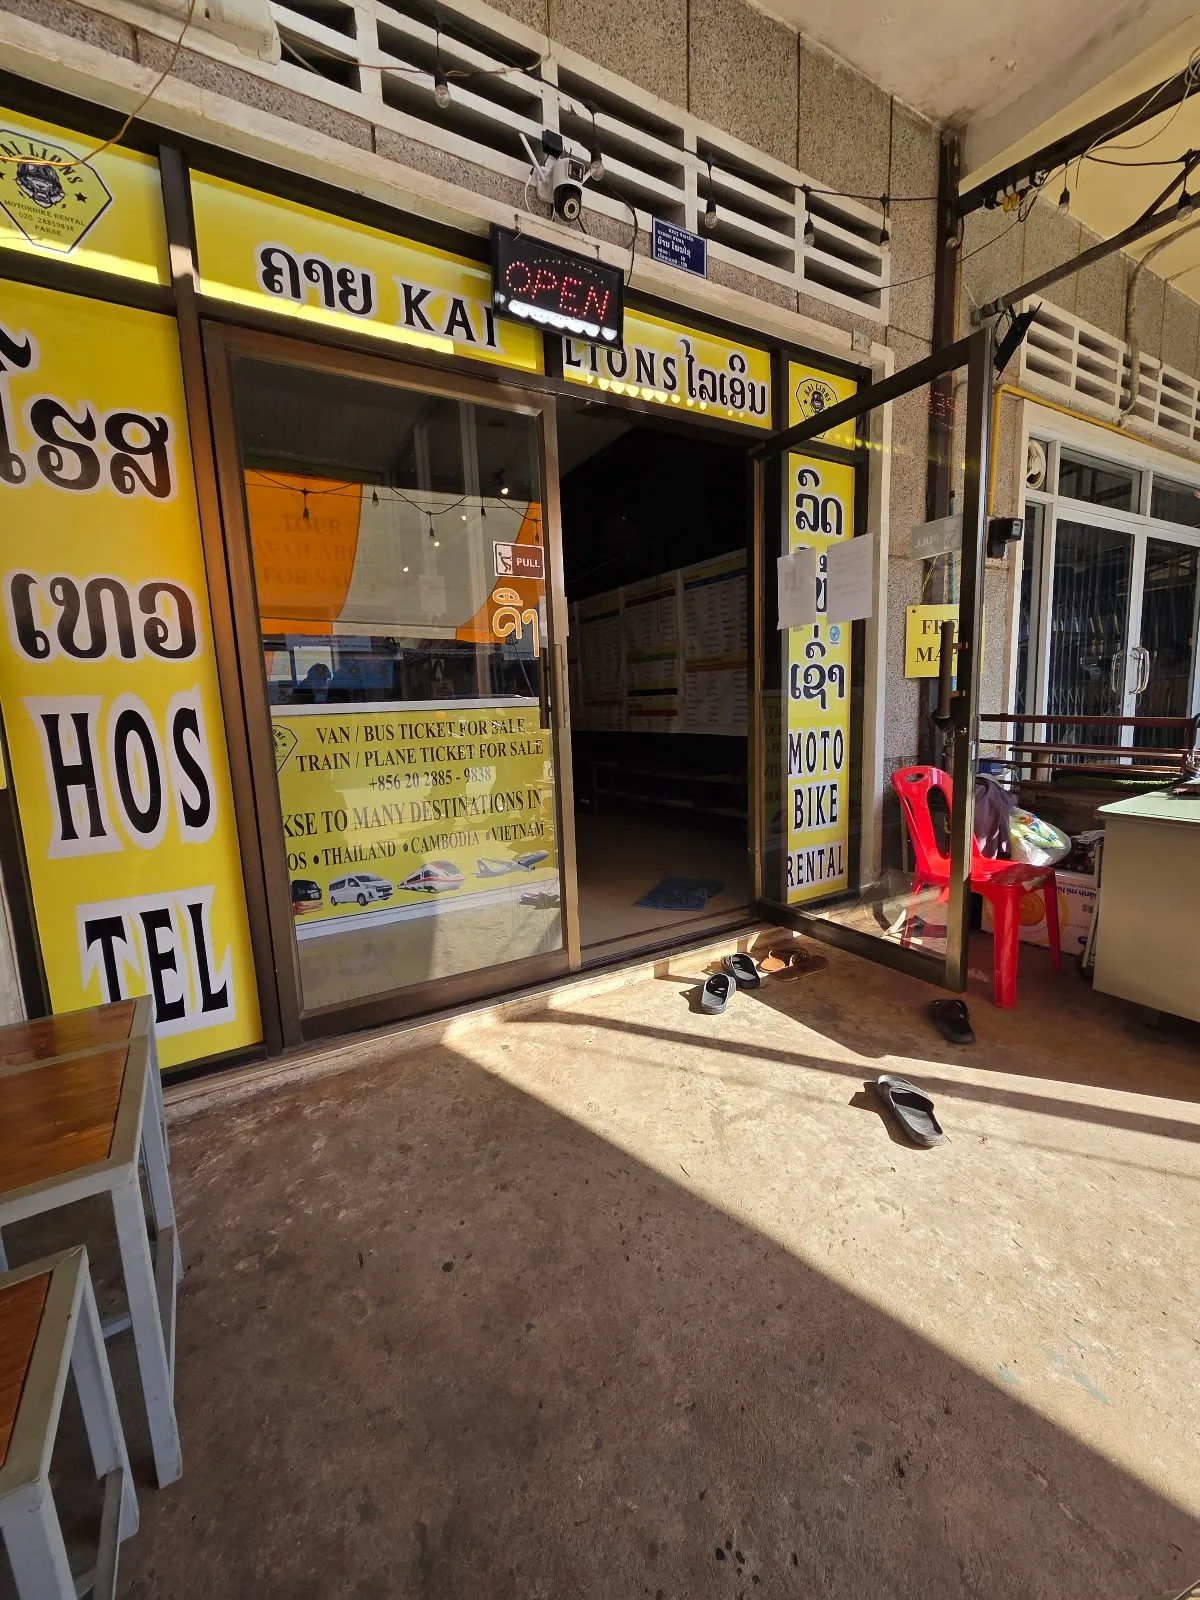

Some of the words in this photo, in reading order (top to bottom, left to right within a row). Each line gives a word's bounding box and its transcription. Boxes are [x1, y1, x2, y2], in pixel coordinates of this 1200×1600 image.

[0, 141, 22, 163] AI
[4, 200, 52, 217] MOTORBIKE
[54, 213, 86, 226] RENTAL
[19, 213, 33, 221] 020
[35, 225, 62, 236] PAKSE
[505, 260, 611, 321] OPEN
[401, 282, 497, 348] KAI
[564, 337, 677, 391] LIONS
[815, 383, 832, 402] LIONS
[516, 556, 541, 568] PULL
[315, 726, 351, 744] VAN
[364, 723, 395, 742] BUS
[397, 720, 455, 740] TICKET
[458, 718, 489, 738] FOR
[491, 717, 526, 735] SALE
[296, 751, 351, 773] TRAIN
[364, 748, 417, 768] PLANE
[419, 743, 476, 764] TICKET
[479, 740, 507, 760] FOR
[510, 738, 544, 757] SALE
[788, 729, 844, 775] MOTO
[41, 707, 211, 841] HOS
[368, 772, 401, 791] +856
[404, 771, 420, 789] 20
[423, 768, 453, 788] 2885
[463, 765, 492, 784] 9838
[321, 808, 348, 833] TO
[352, 803, 406, 830] MANY
[410, 790, 524, 824] DESTINATIONS
[527, 788, 542, 808] IN
[793, 783, 838, 830] BIKE
[321, 839, 397, 867] THAILAND
[411, 828, 480, 855] CAMBODIA
[491, 821, 545, 842] VIETNAM
[787, 844, 844, 887] RENTAL
[85, 903, 229, 1024] TEL
